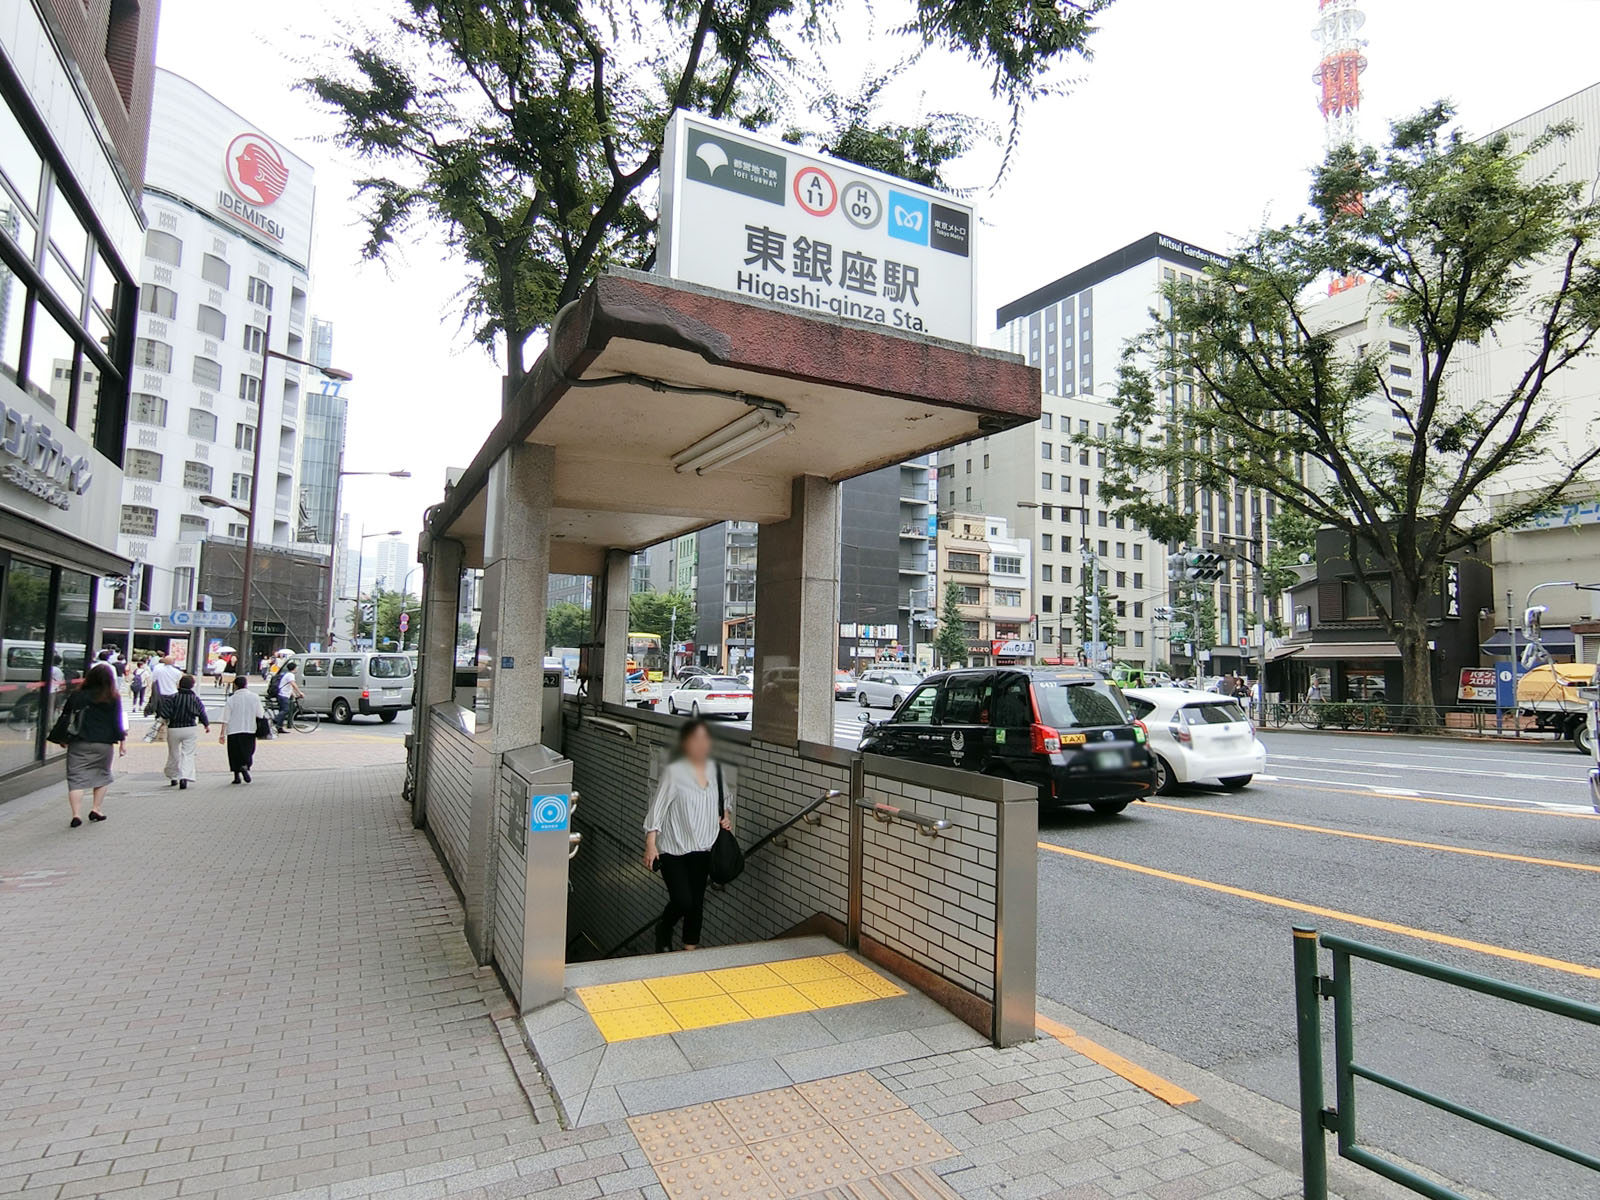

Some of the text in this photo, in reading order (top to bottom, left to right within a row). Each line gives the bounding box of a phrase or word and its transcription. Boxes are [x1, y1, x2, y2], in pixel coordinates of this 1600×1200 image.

[733, 159, 779, 180] 都営地下鉄
[733, 170, 779, 189] TOEI SUBWAY
[810, 176, 822, 190] A
[806, 190, 825, 207] 11
[857, 190, 868, 204] H
[218, 190, 286, 241] IDEMITSU
[851, 205, 873, 221] 09
[934, 219, 967, 235] 東京メトロ
[936, 228, 965, 242] Tokyo Metro
[1158, 236, 1229, 269] Mitsui Garden Hotel
[744, 224, 921, 307] 東銀座駅
[736, 269, 929, 334] Higashi-ginza Sta.
[320, 380, 342, 397] 77
[1061, 735, 1086, 744] TAXI
